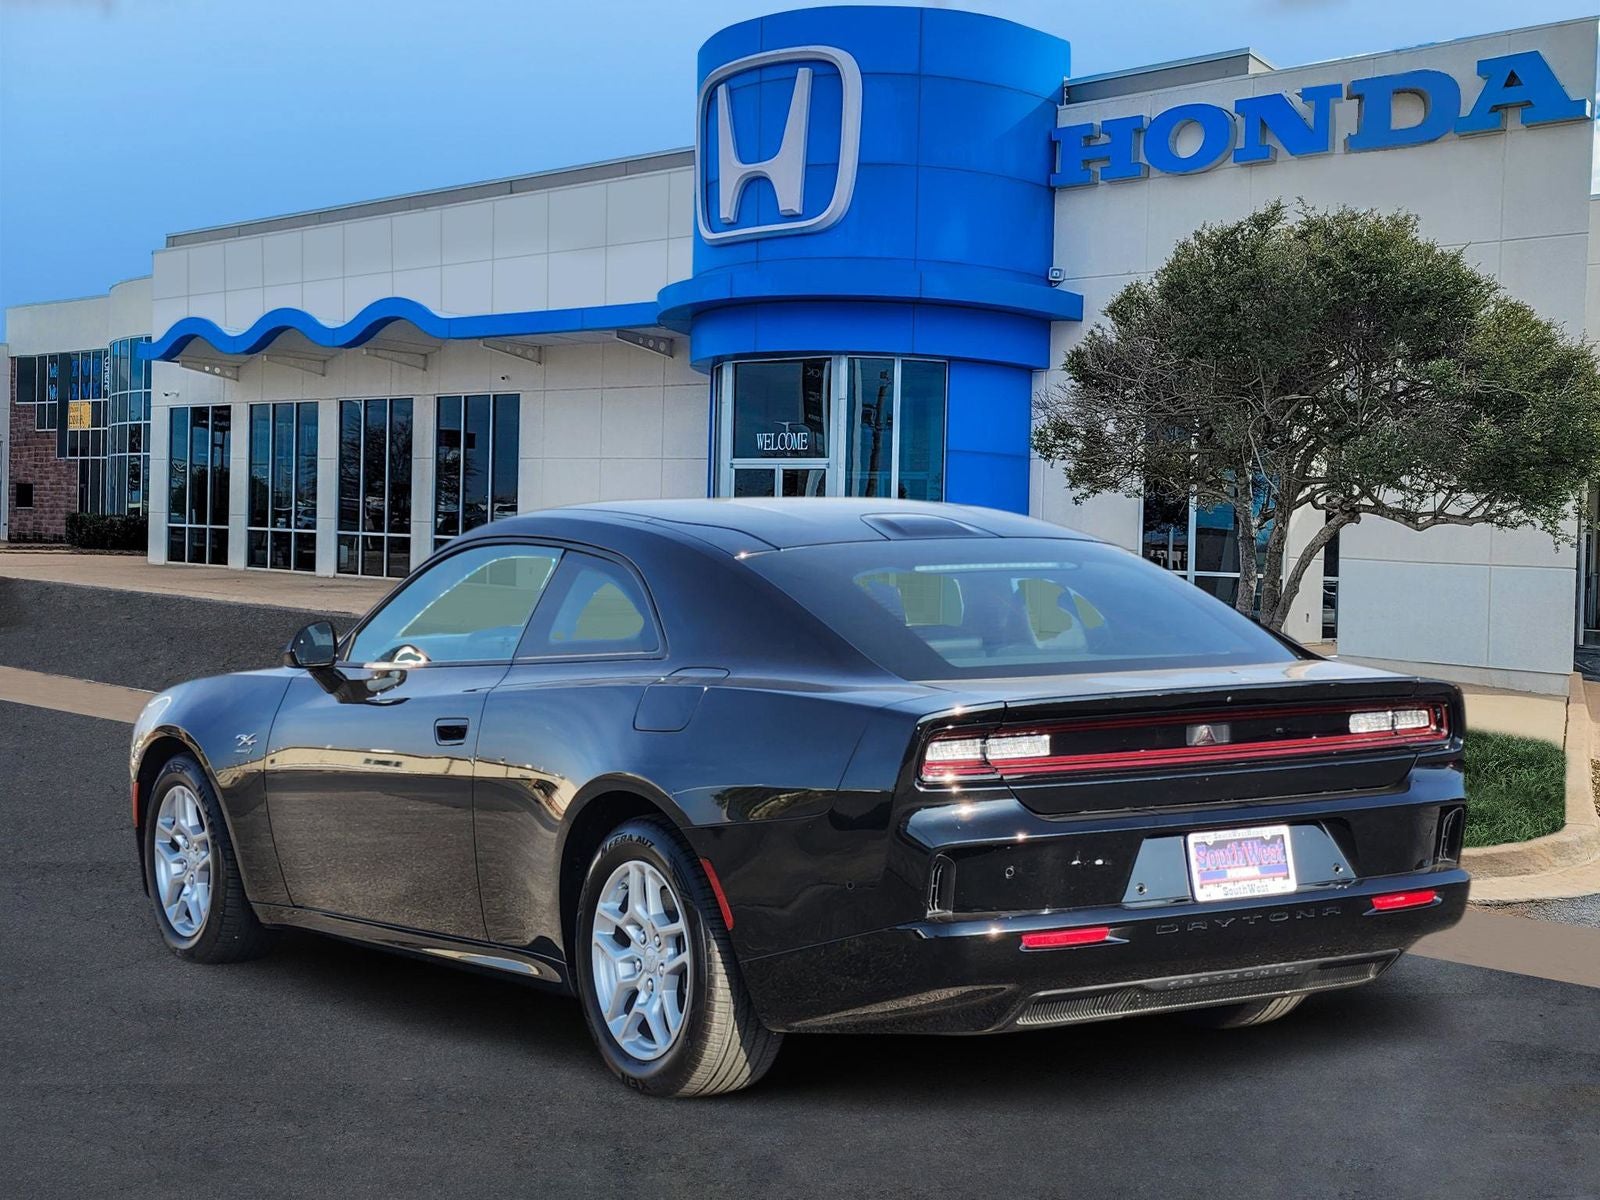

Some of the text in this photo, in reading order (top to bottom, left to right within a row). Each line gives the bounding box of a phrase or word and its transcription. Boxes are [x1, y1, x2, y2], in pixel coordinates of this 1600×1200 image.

[1050, 50, 1591, 188] HONDA
[756, 432, 808, 451] WELCOME
[1195, 838, 1287, 870] SouthWest
[1156, 907, 1341, 934] DAYTONA
